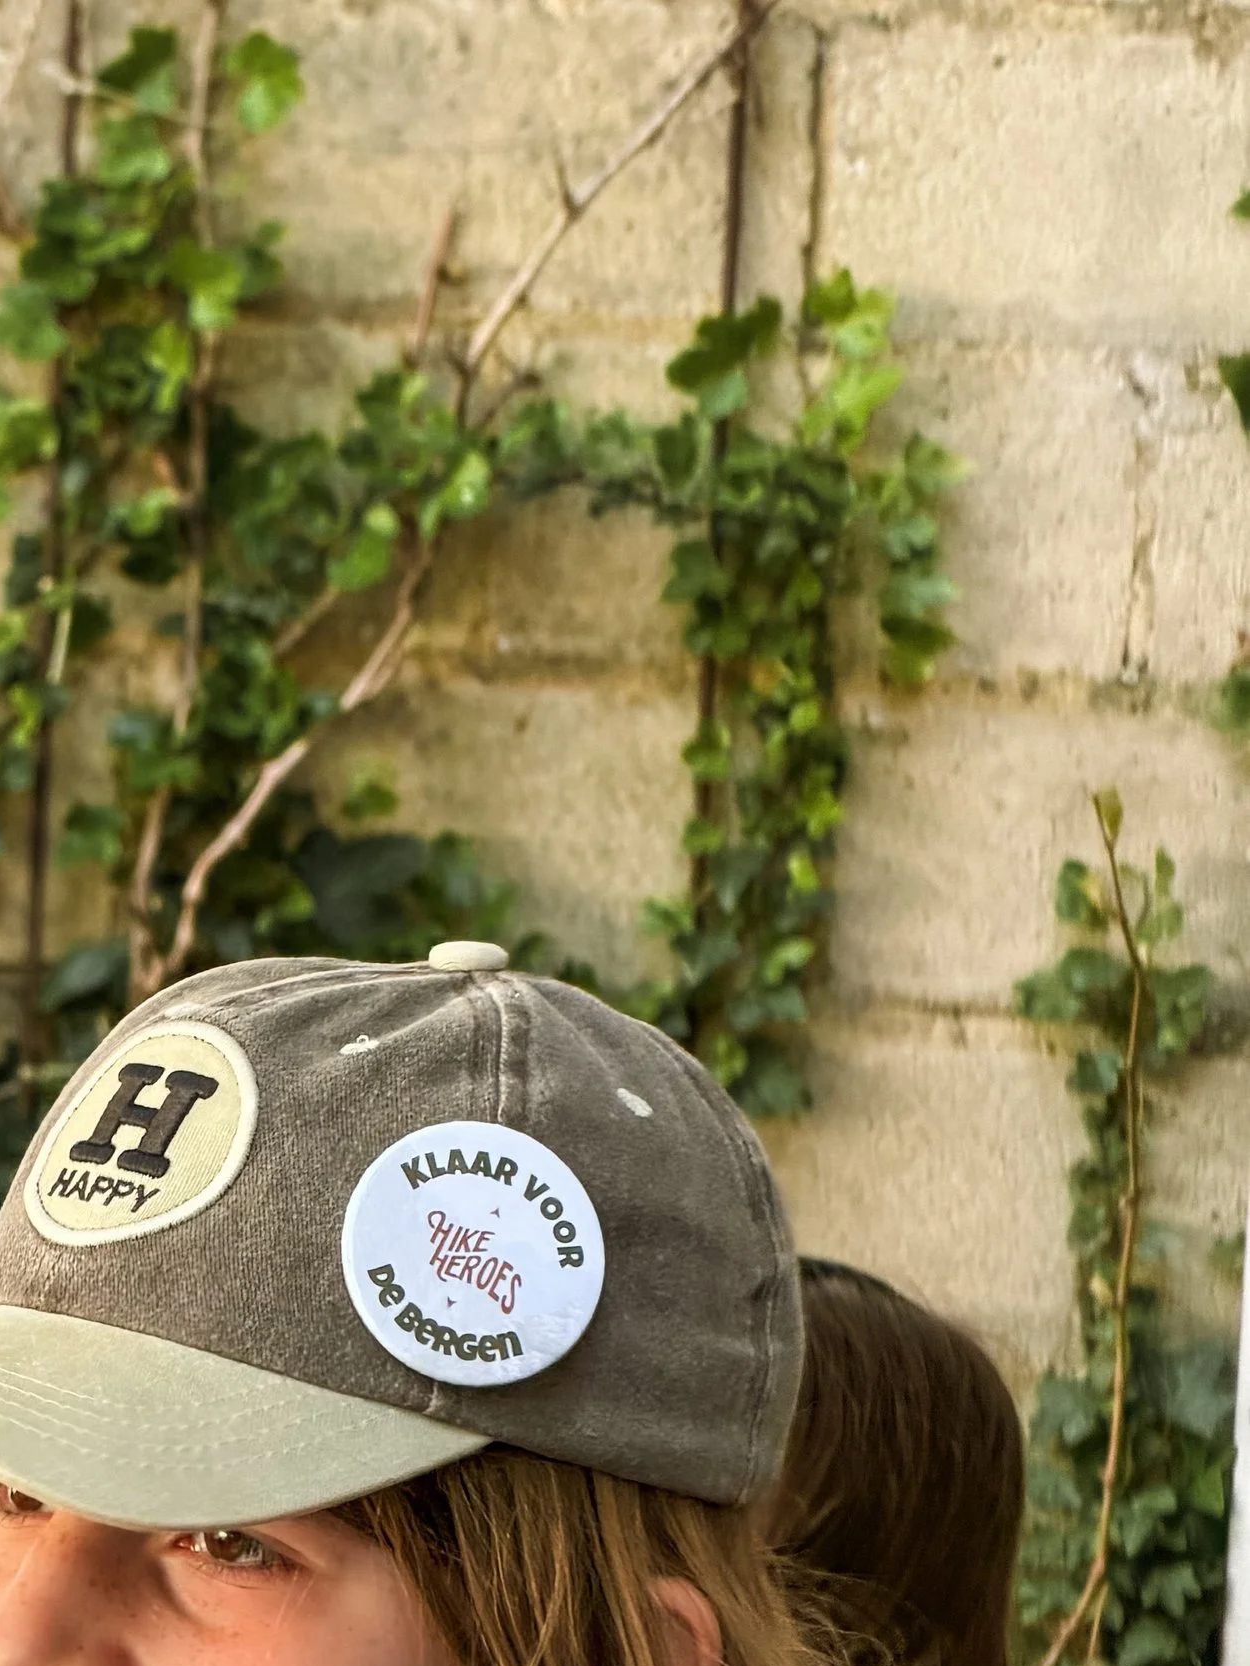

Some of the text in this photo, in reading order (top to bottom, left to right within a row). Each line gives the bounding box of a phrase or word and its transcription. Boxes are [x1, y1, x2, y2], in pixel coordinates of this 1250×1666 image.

[69, 1062, 220, 1179] H
[47, 1167, 160, 1213] HAPPY
[400, 1148, 585, 1269] KLAAR VOOR
[427, 1210, 496, 1255] HIKE
[429, 1250, 523, 1315] HEROES
